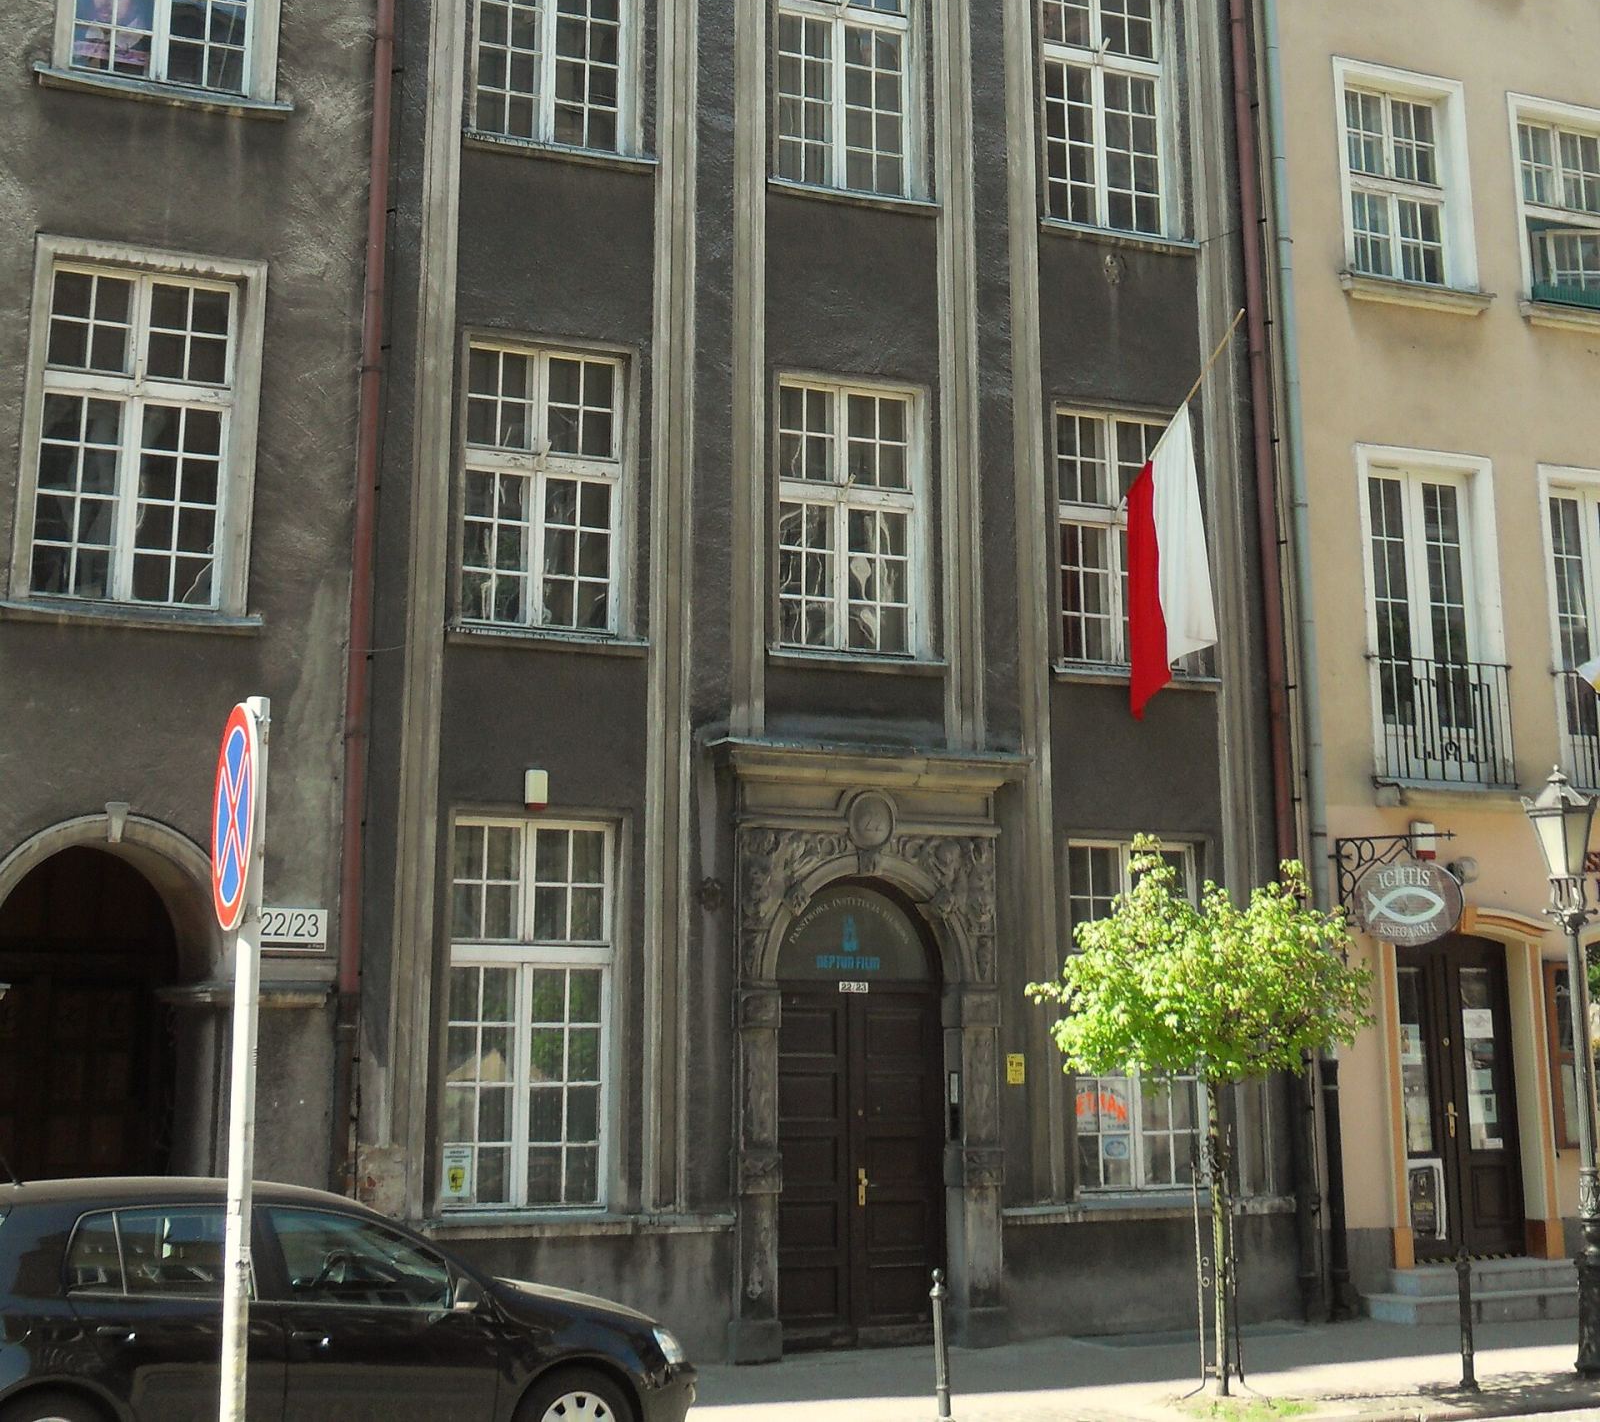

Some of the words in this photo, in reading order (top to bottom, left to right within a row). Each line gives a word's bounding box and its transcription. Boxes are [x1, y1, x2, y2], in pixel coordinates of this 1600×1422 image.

[1378, 866, 1431, 889] ICHTIS
[261, 912, 319, 937] 22/23
[816, 954, 854, 969] NEPTUN
[856, 955, 880, 970] FILM
[841, 982, 867, 993] 22/23
